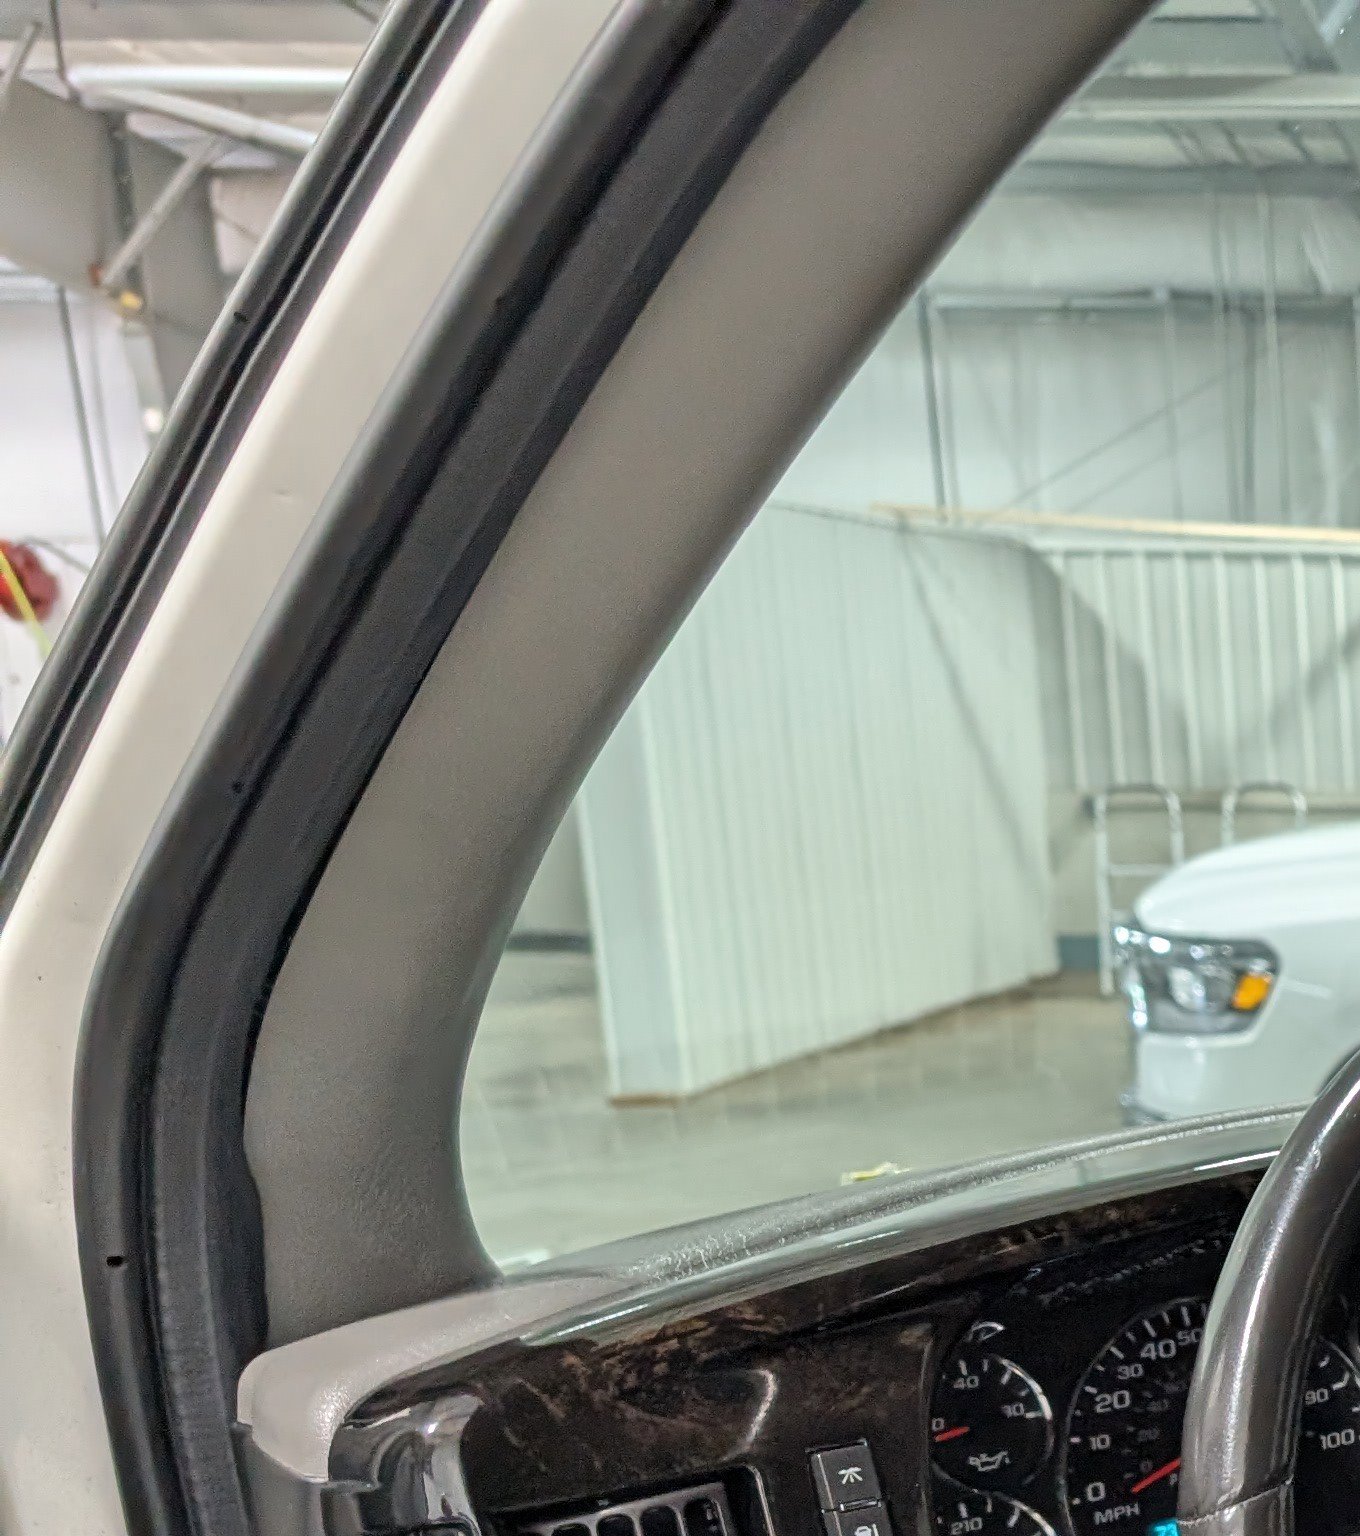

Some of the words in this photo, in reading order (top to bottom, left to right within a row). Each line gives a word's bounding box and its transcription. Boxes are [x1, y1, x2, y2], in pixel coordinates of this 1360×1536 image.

[1140, 1338, 1177, 1361] 40
[1117, 1363, 1145, 1380] 30
[953, 1375, 979, 1390] 40
[1094, 1389, 1131, 1413] 20
[1089, 1434, 1111, 1451] 10
[1320, 1428, 1355, 1450] 100
[1085, 1481, 1106, 1502] 0
[1093, 1502, 1141, 1525] MPH
[949, 1516, 983, 1536] 210
